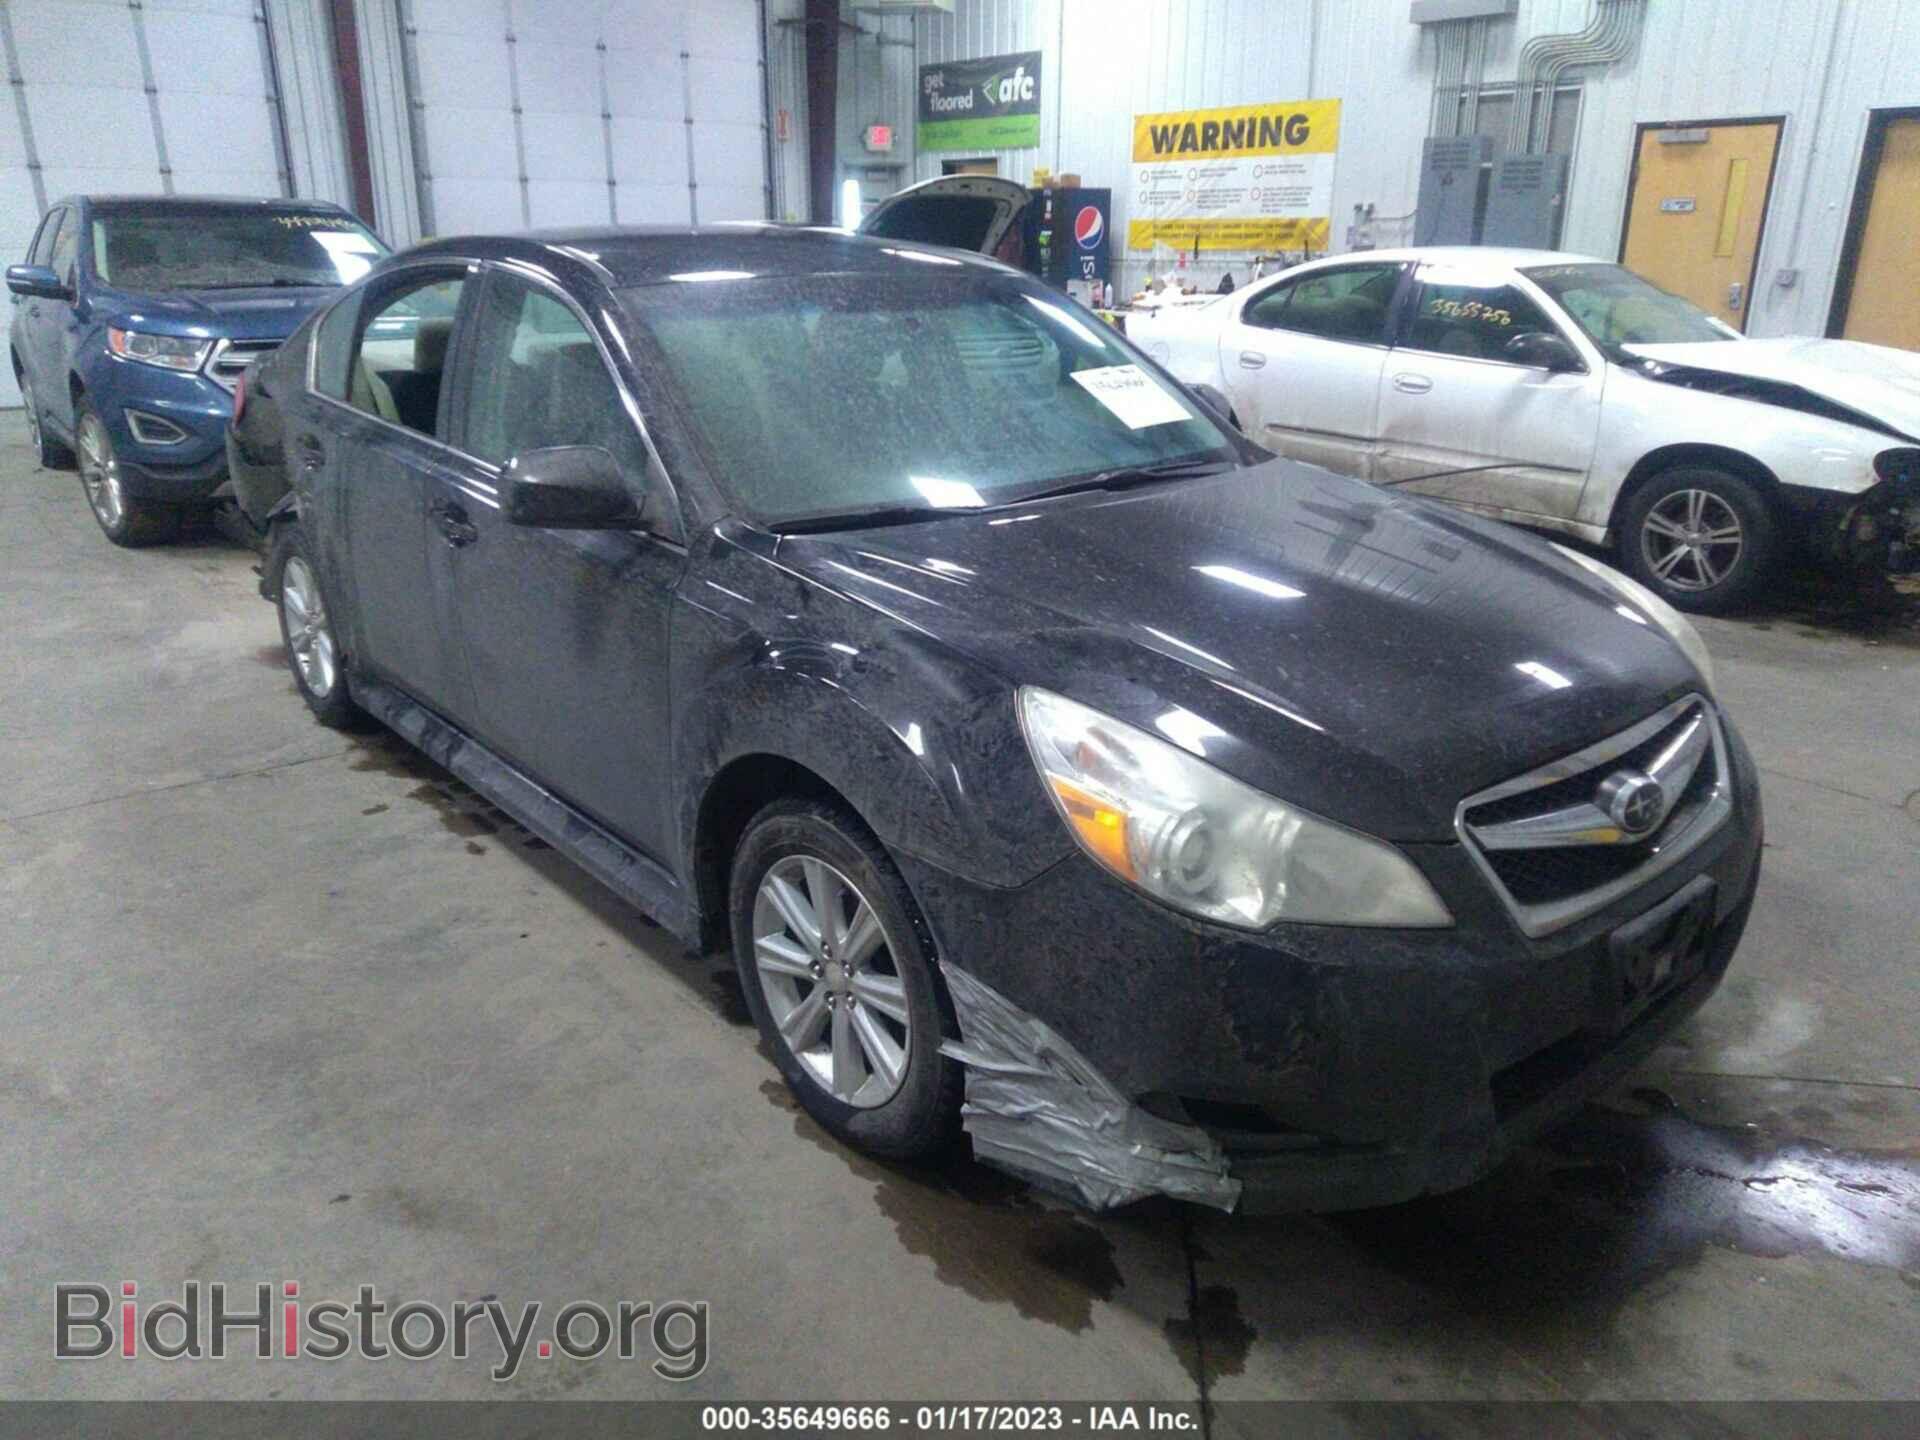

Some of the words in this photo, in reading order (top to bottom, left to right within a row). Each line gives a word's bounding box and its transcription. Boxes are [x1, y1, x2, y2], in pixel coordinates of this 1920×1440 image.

[924, 70, 944, 95] get
[999, 66, 1034, 103] afc
[931, 88, 974, 112] floored
[1151, 114, 1310, 154] WARNING
